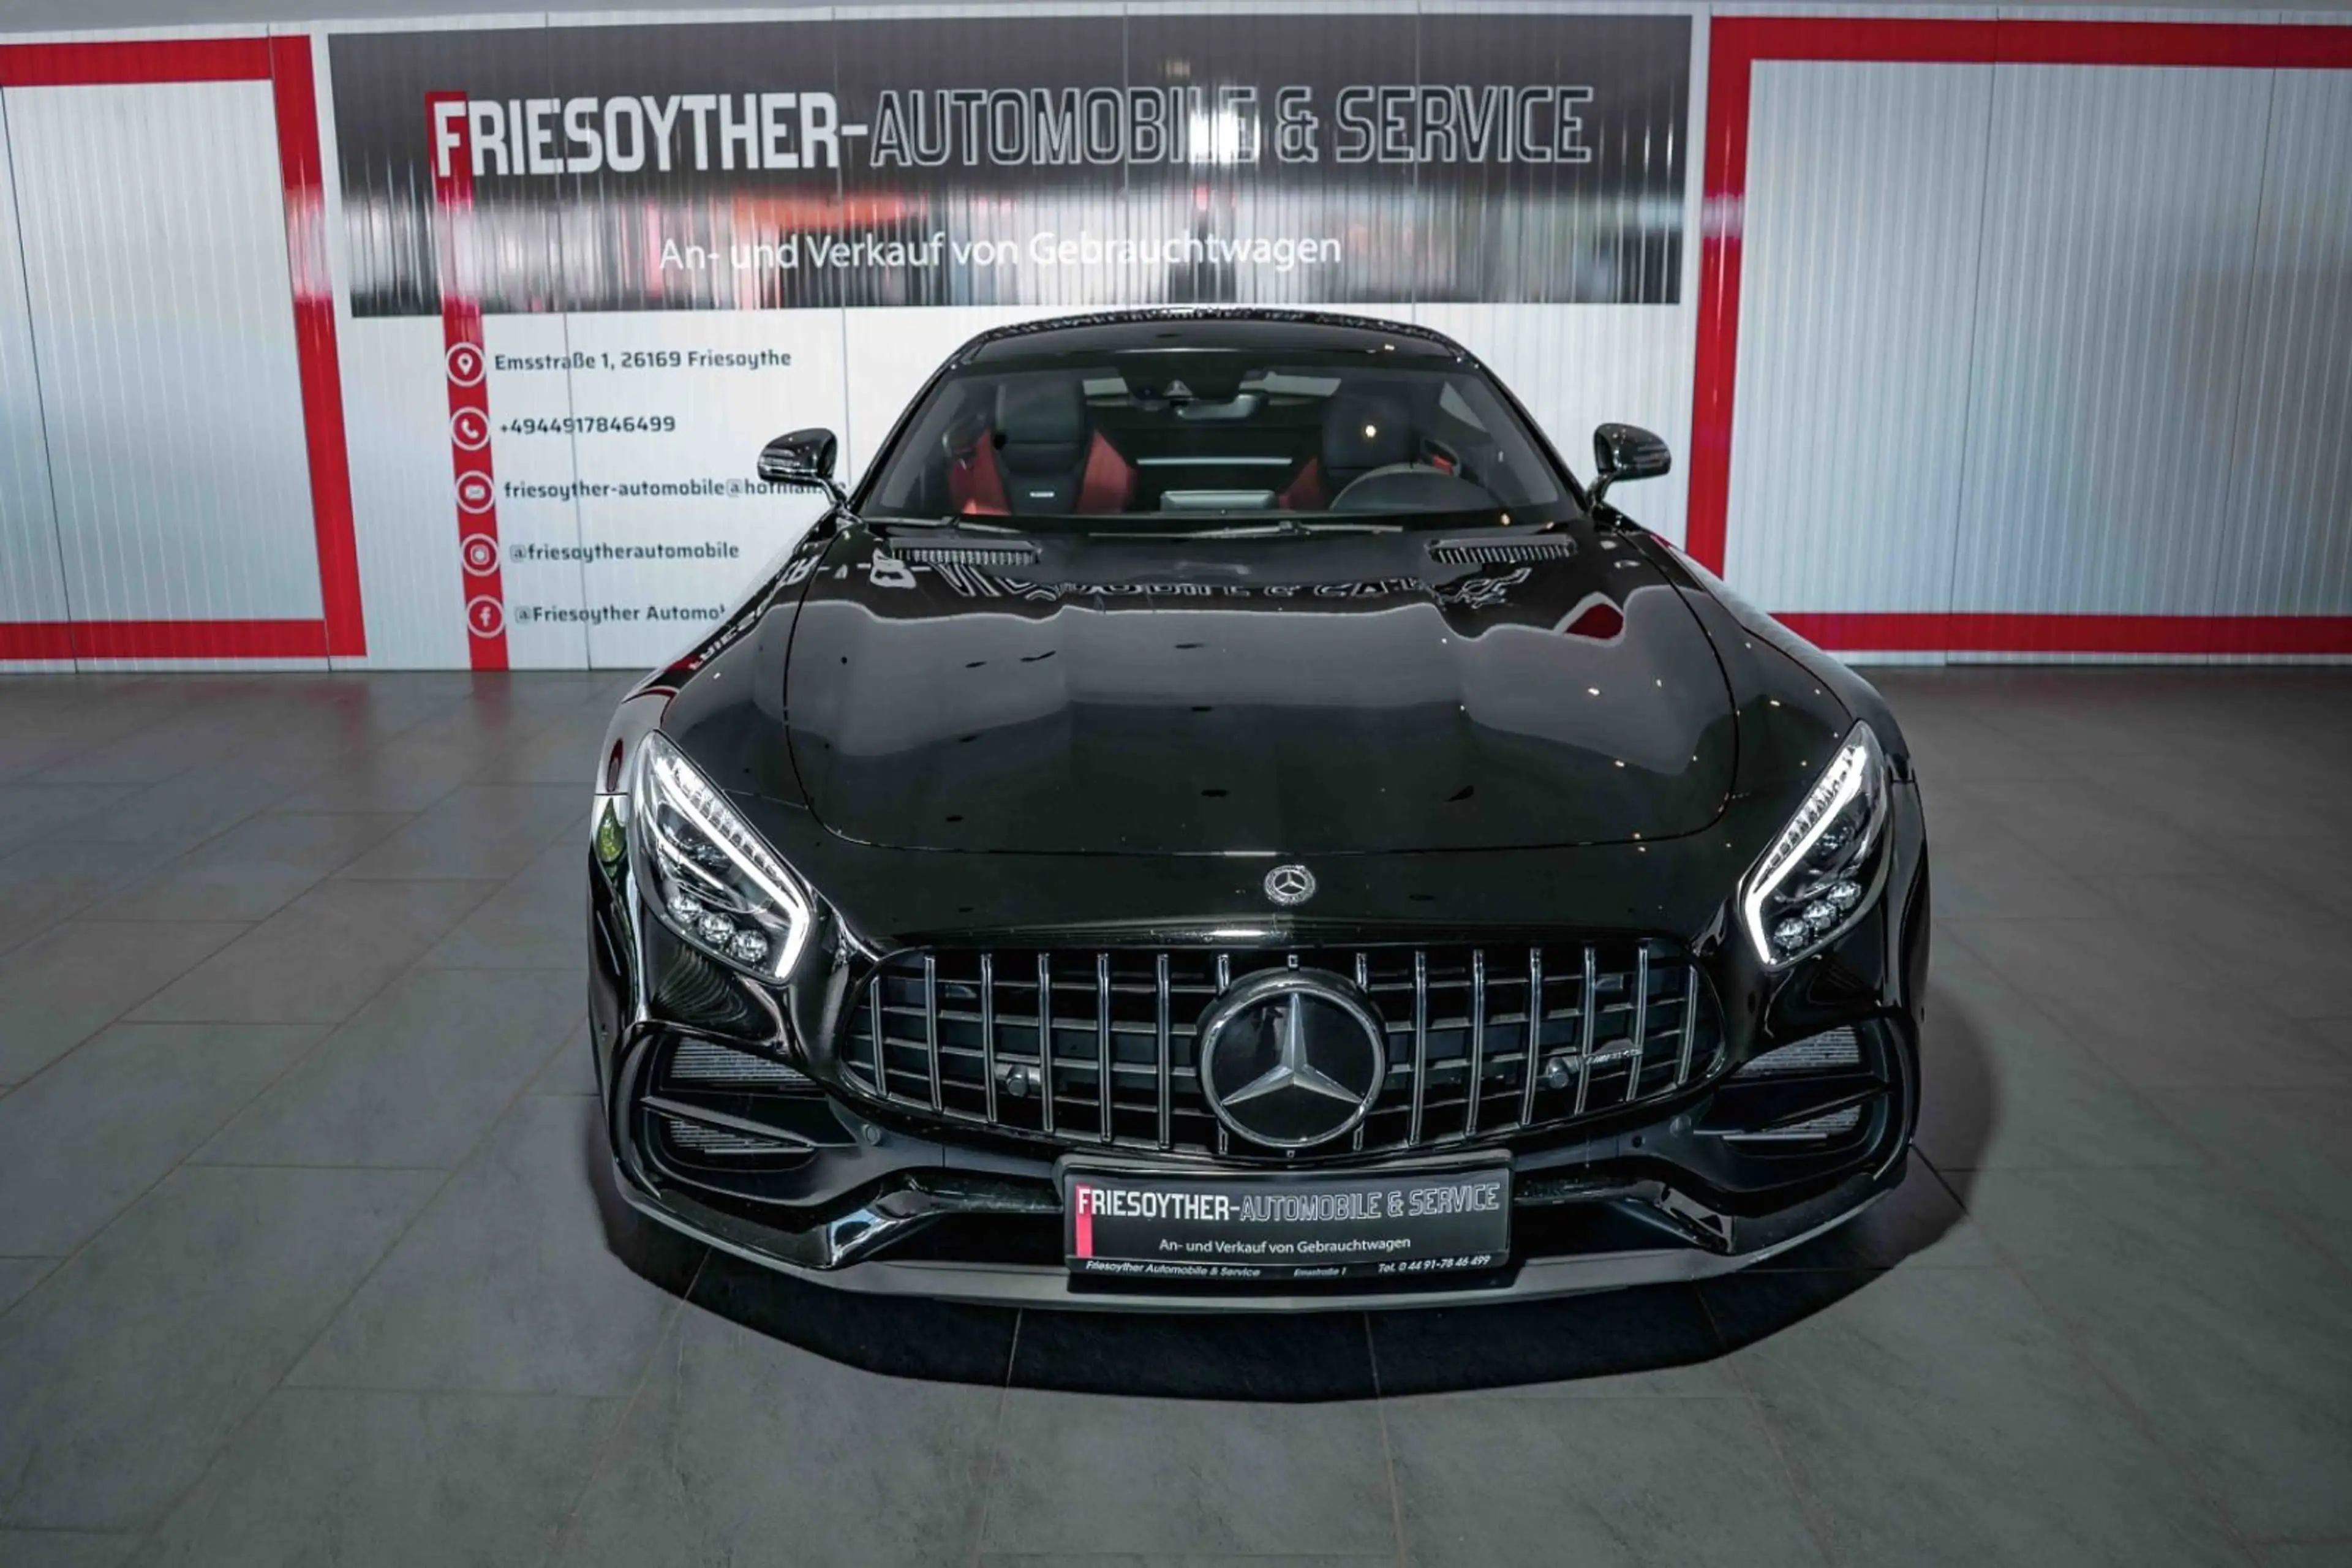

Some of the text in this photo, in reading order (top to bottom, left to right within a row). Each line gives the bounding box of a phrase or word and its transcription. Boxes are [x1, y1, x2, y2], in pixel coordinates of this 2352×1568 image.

[1275, 86, 1319, 162] &
[1336, 86, 1593, 163] SERVICE
[660, 230, 1341, 271] An- und Verkauf von Gebrauchtwagen
[495, 349, 792, 372] Emsstraße 1, 26169 Friesoythe
[500, 416, 676, 434] +4944917846499
[510, 541, 739, 564] @friesoytherautomobile
[514, 603, 640, 625] @Friesoyther
[1079, 1182, 1501, 1221] FRIESOYTHER-AUTOMOBILE & SERVICE
[1159, 1238, 1411, 1253] An- und Verkauf von Gebrauchtwagen
[1085, 1260, 1144, 1273] Friesoyther
[1145, 1264, 1207, 1276] Automobile
[1210, 1267, 1218, 1276] &
[1220, 1267, 1261, 1277] Service
